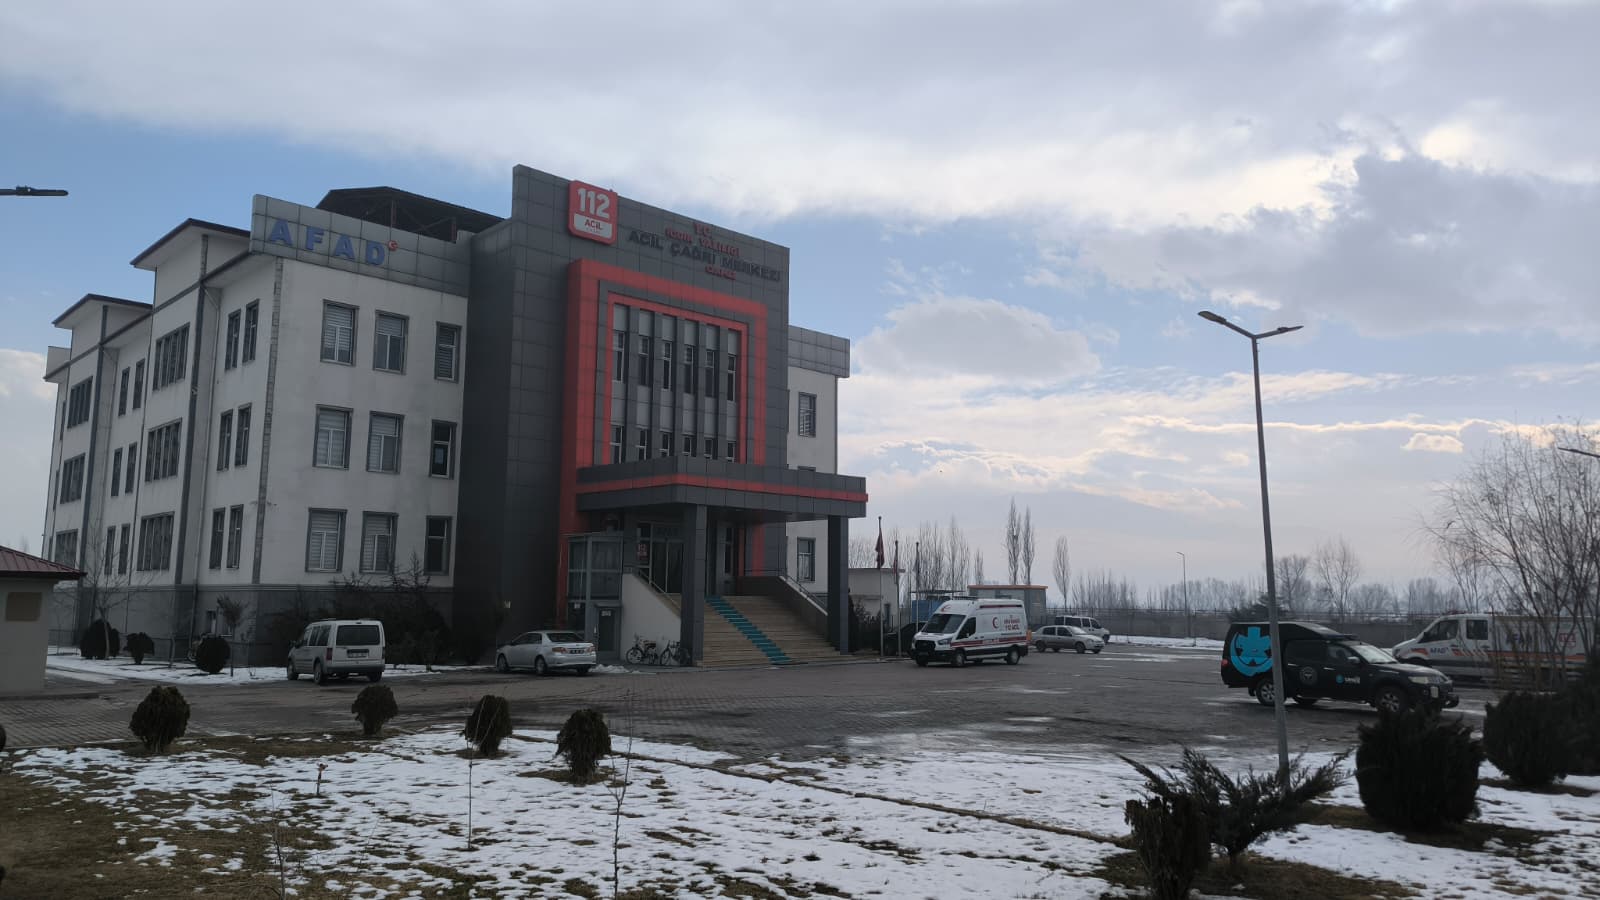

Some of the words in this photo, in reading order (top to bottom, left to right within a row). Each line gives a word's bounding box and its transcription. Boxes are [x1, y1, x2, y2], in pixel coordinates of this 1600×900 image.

[577, 187, 610, 219] 112
[268, 218, 386, 267] AFAD
[629, 230, 663, 250] ACİL
